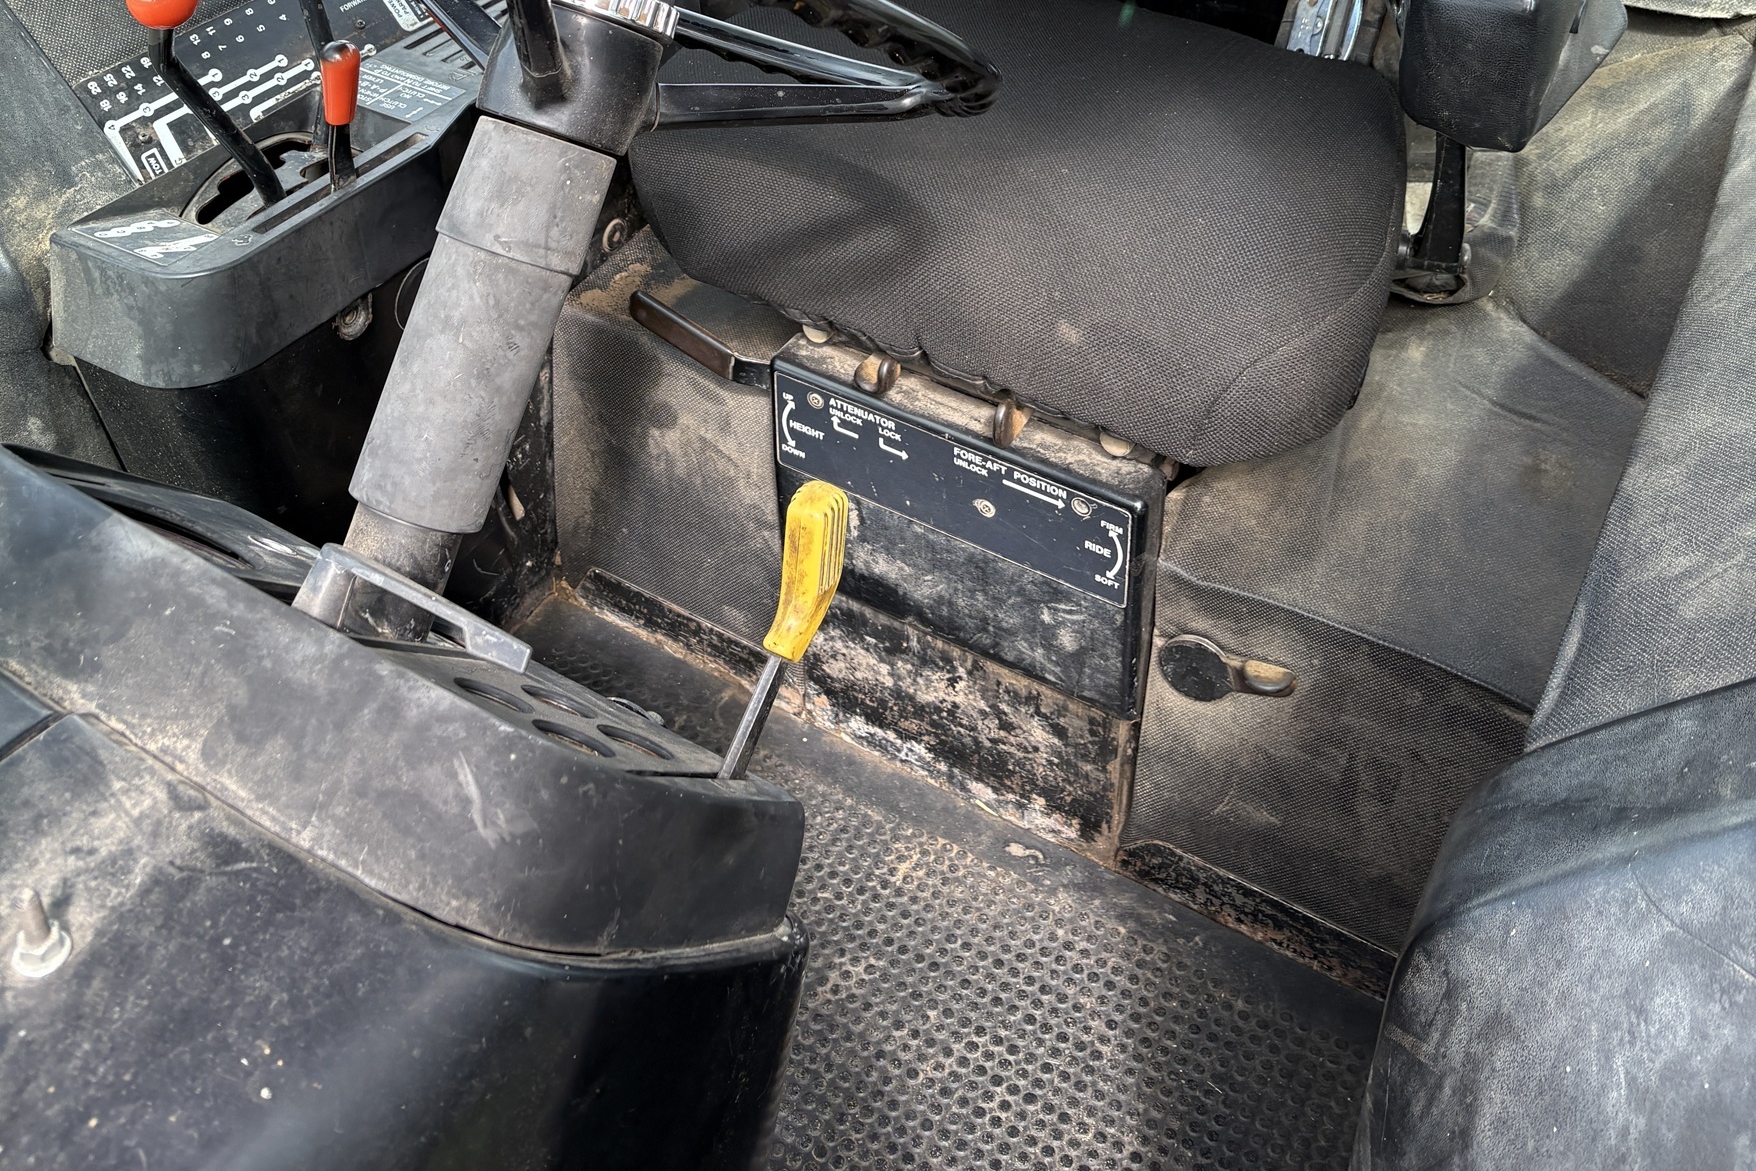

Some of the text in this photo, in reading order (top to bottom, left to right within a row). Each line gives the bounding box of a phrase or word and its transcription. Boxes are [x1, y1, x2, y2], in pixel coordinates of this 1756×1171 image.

[245, 7, 254, 15] 8
[206, 26, 217, 36] 11
[189, 34, 211, 59] 8 13
[121, 65, 146, 95] 14 22
[140, 57, 165, 86] 12 19
[87, 81, 112, 112] 18 29
[103, 74, 128, 104] 16 25
[147, 157, 162, 175] TOW
[782, 392, 794, 402] UP
[828, 397, 896, 430] ATTENUATOR
[828, 407, 863, 427] UNLOCK
[789, 420, 825, 441] HEIGHT
[878, 427, 902, 442] LOCK
[781, 444, 806, 459] DOWN
[953, 458, 989, 477] UNLOCK
[953, 446, 1067, 499] FORE-AFT POSITION
[1100, 520, 1124, 535] FIRM
[1084, 540, 1112, 558] RIDE
[1094, 574, 1120, 590] SOFT
